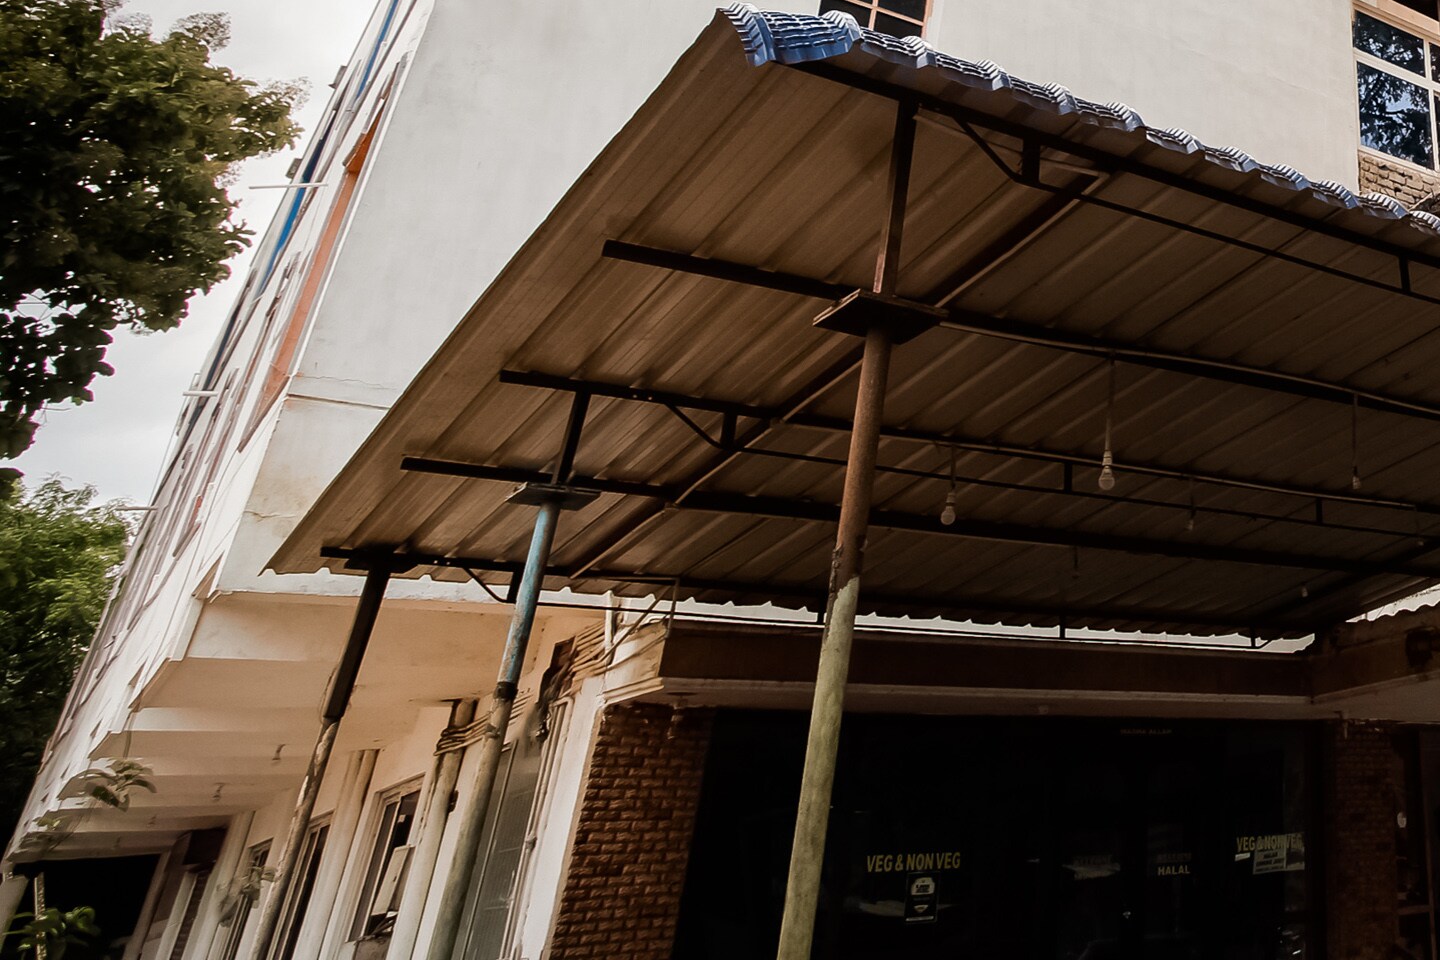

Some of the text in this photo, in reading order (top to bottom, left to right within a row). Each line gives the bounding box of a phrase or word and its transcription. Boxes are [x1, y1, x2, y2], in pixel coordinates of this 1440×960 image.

[1236, 835, 1256, 852] VEG
[867, 851, 961, 873] VEG & NON VEG
[1157, 864, 1191, 876] HALAL
